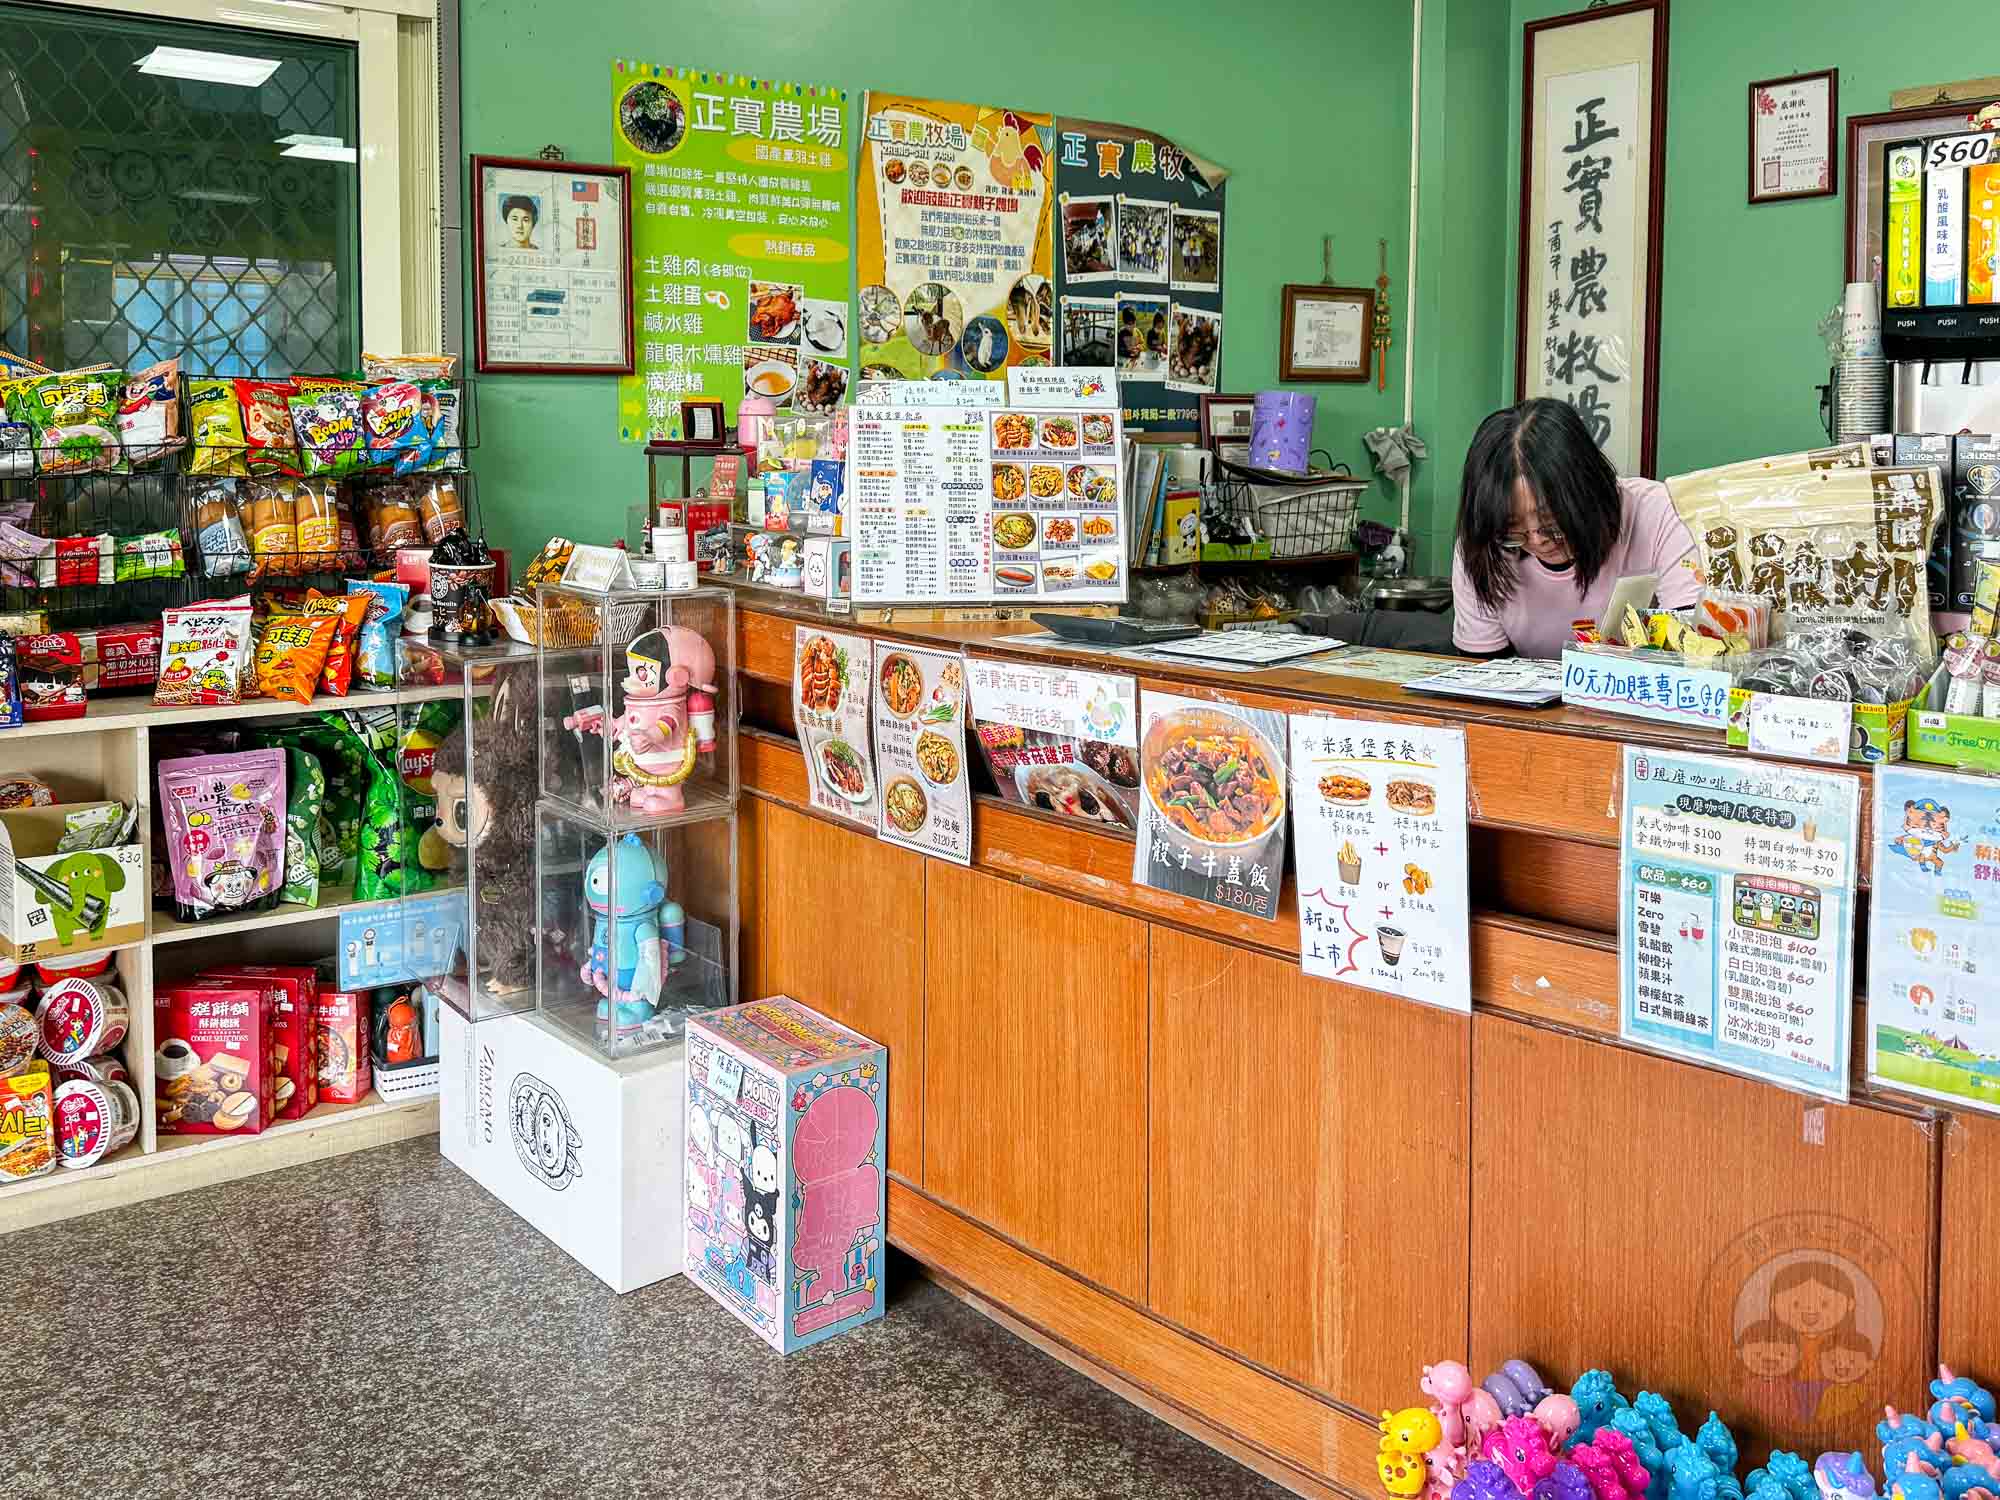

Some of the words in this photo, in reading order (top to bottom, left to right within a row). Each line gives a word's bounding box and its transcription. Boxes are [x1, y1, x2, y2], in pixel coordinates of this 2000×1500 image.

[691, 91, 842, 149] 正實農場
[869, 116, 967, 150] 正實農牧場
[1061, 132, 1186, 181] 正實農牧
[1930, 138, 1989, 168] $60
[1937, 188, 1949, 256] 乳酸風味飲
[644, 284, 703, 306] 土雞蛋
[644, 312, 703, 335] 鹹水雞
[1897, 319, 1916, 328] PUSH
[1937, 318, 1957, 327] PUSH
[1979, 316, 2000, 325] PUSH
[40, 384, 107, 407] 可樂果
[181, 616, 230, 626] ベビースター
[189, 627, 219, 638] ラーメン
[267, 626, 314, 647] 可樂果
[976, 667, 1080, 699] 消費滿百可使用
[1565, 662, 1700, 709] 10元加購專區
[991, 703, 1063, 729] 一張折抵券
[1322, 737, 1417, 762] 米漢堡套餐
[401, 752, 431, 775] Lay's
[1678, 795, 1795, 828] 現磨咖啡/限定特調
[933, 815, 961, 835] 炒泡麵
[1332, 820, 1370, 837] $180元
[1635, 815, 1691, 835] 美式咖啡
[1693, 826, 1722, 841] $100
[933, 832, 959, 850] $120元
[1693, 843, 1721, 858] $130
[1744, 837, 1814, 859] 特調白咖啡
[1816, 850, 1838, 862] $70
[118, 851, 142, 864] $30
[1152, 839, 1271, 892] 骰子牛蓋飯
[1744, 853, 1798, 871] 特調奶茶
[1377, 880, 1390, 891] or
[1640, 866, 1666, 883] 飲品
[1680, 878, 1708, 890] $60
[1639, 890, 1662, 905] 可樂
[1304, 907, 1340, 935] 新品
[1638, 906, 1664, 921] Zero
[1638, 921, 1662, 936] 雪碧
[21, 943, 36, 954] 22
[1638, 937, 1673, 954] 乳酸飲
[1728, 928, 1783, 949] 小黑泡泡
[1787, 941, 1817, 956] $100
[1308, 941, 1342, 969] 上市
[1638, 952, 1673, 970] 柳橙汁
[1638, 968, 1673, 986] 蘋果汁
[1728, 957, 1782, 980] 白白泡泡
[1787, 971, 1815, 986] $60
[1638, 985, 1686, 1008] 檸檬紅茶
[1728, 985, 1782, 1009] 雙黑泡泡
[1787, 1001, 1815, 1016] $60
[1639, 1001, 1710, 1030] 日式無糖綠茶
[1724, 1027, 1776, 1049] (可樂冰沙)
[1728, 1014, 1781, 1039] 冰冰泡泡
[1786, 1031, 1814, 1046] $60
[743, 1073, 779, 1113] MOLLY
